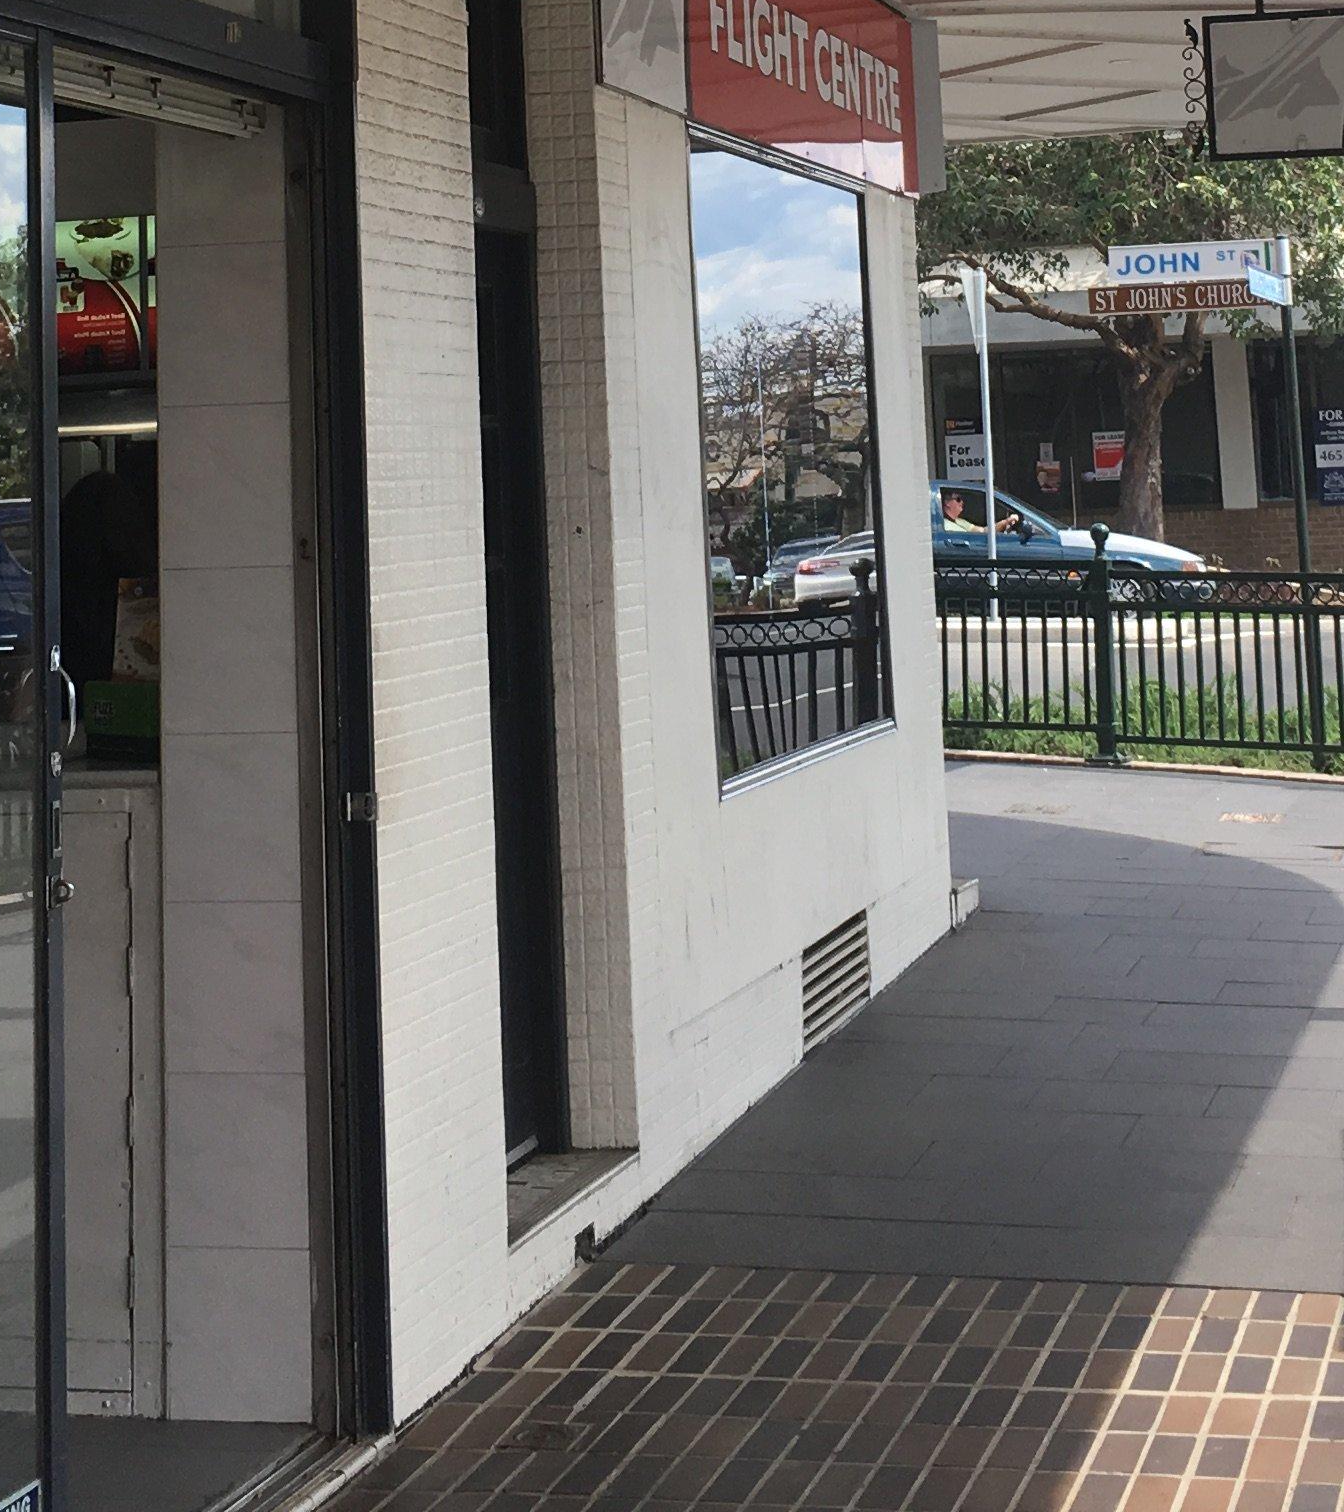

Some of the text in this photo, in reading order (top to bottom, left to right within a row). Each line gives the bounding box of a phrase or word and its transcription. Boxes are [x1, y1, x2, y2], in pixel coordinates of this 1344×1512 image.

[814, 29, 902, 134] CENTRE
[1117, 250, 1236, 275] JOHN ST
[1095, 290, 1117, 311] ST
[1126, 287, 1187, 310] JOHN'S
[1195, 283, 1267, 308] CHURC
[1318, 410, 1342, 421] FOR
[949, 445, 970, 456] For
